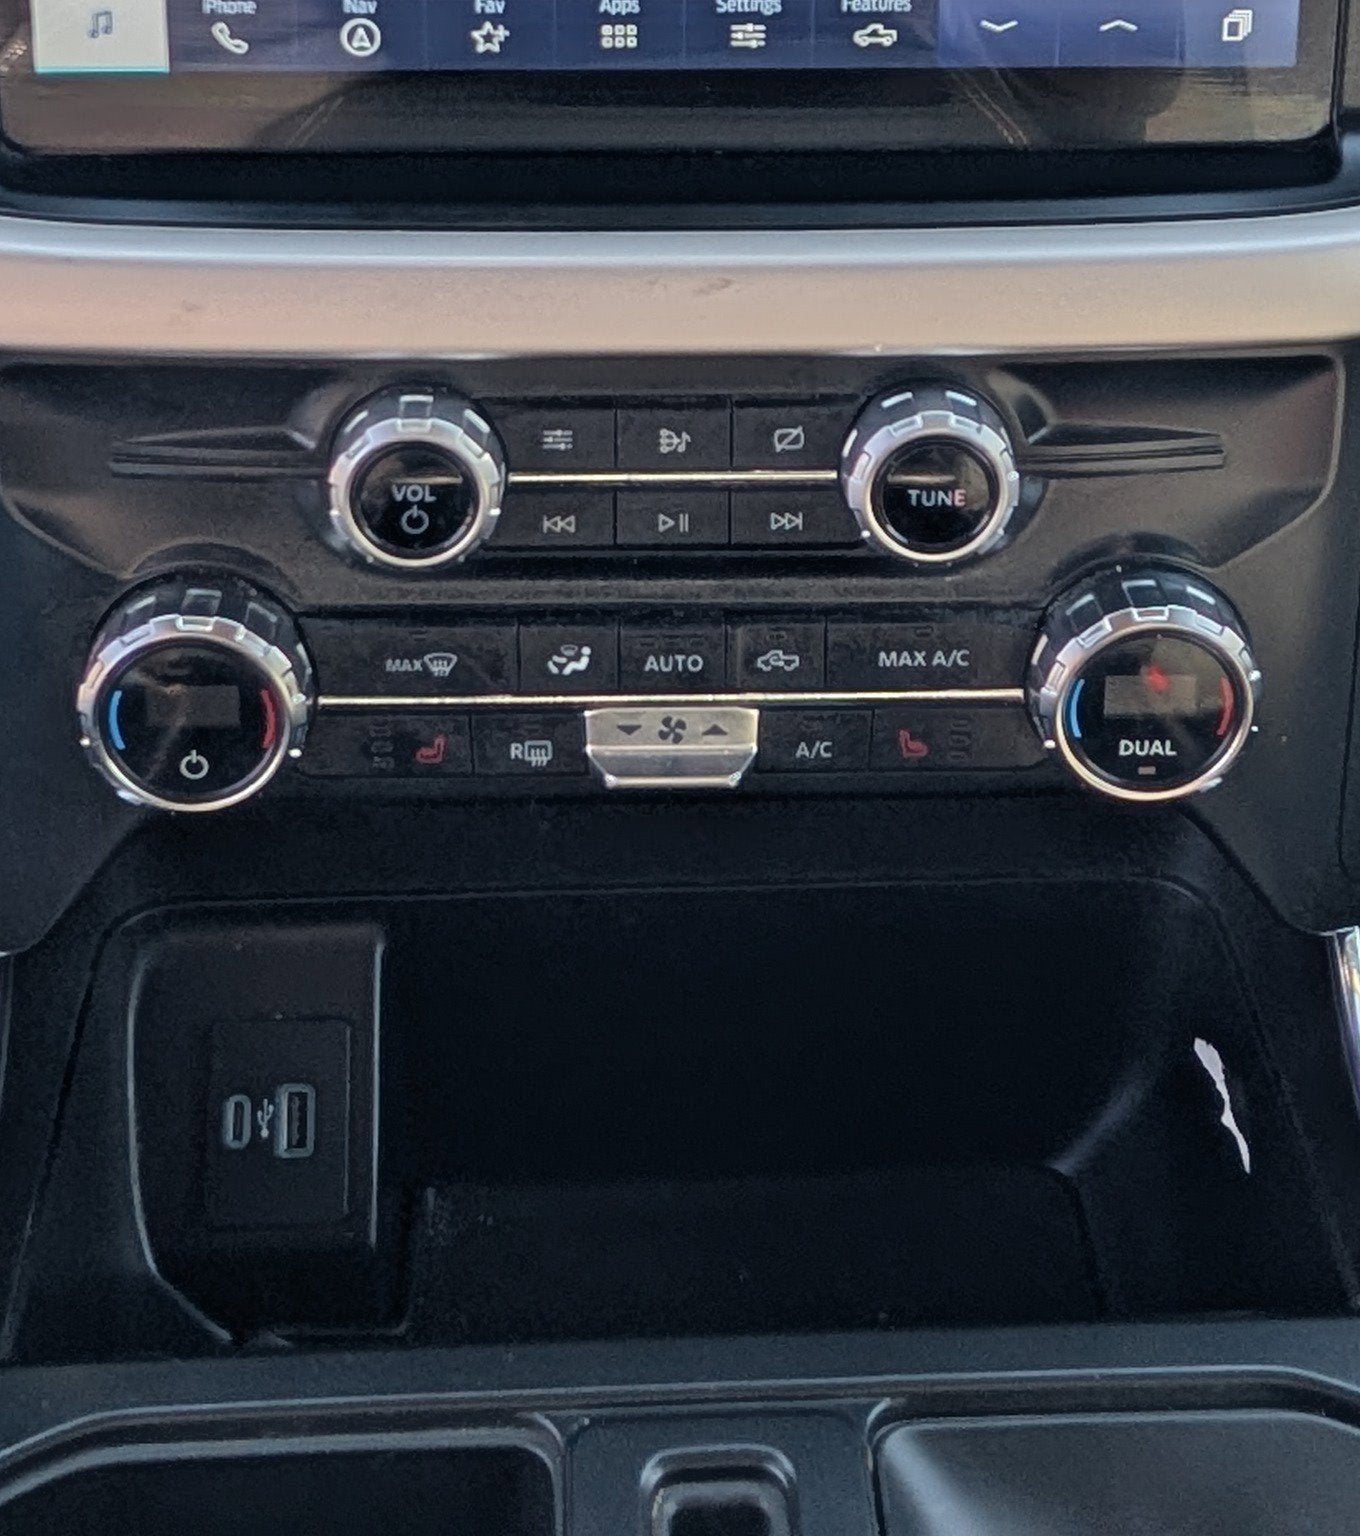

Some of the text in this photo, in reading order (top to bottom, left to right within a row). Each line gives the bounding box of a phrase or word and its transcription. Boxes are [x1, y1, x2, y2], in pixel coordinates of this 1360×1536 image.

[391, 484, 437, 502] VOL
[907, 489, 966, 507] TUNE
[385, 658, 423, 673] MAX
[644, 655, 704, 673] AUTO
[878, 650, 970, 668] MAX A/C
[795, 741, 833, 759] A/C
[1117, 739, 1177, 757] DUAL
